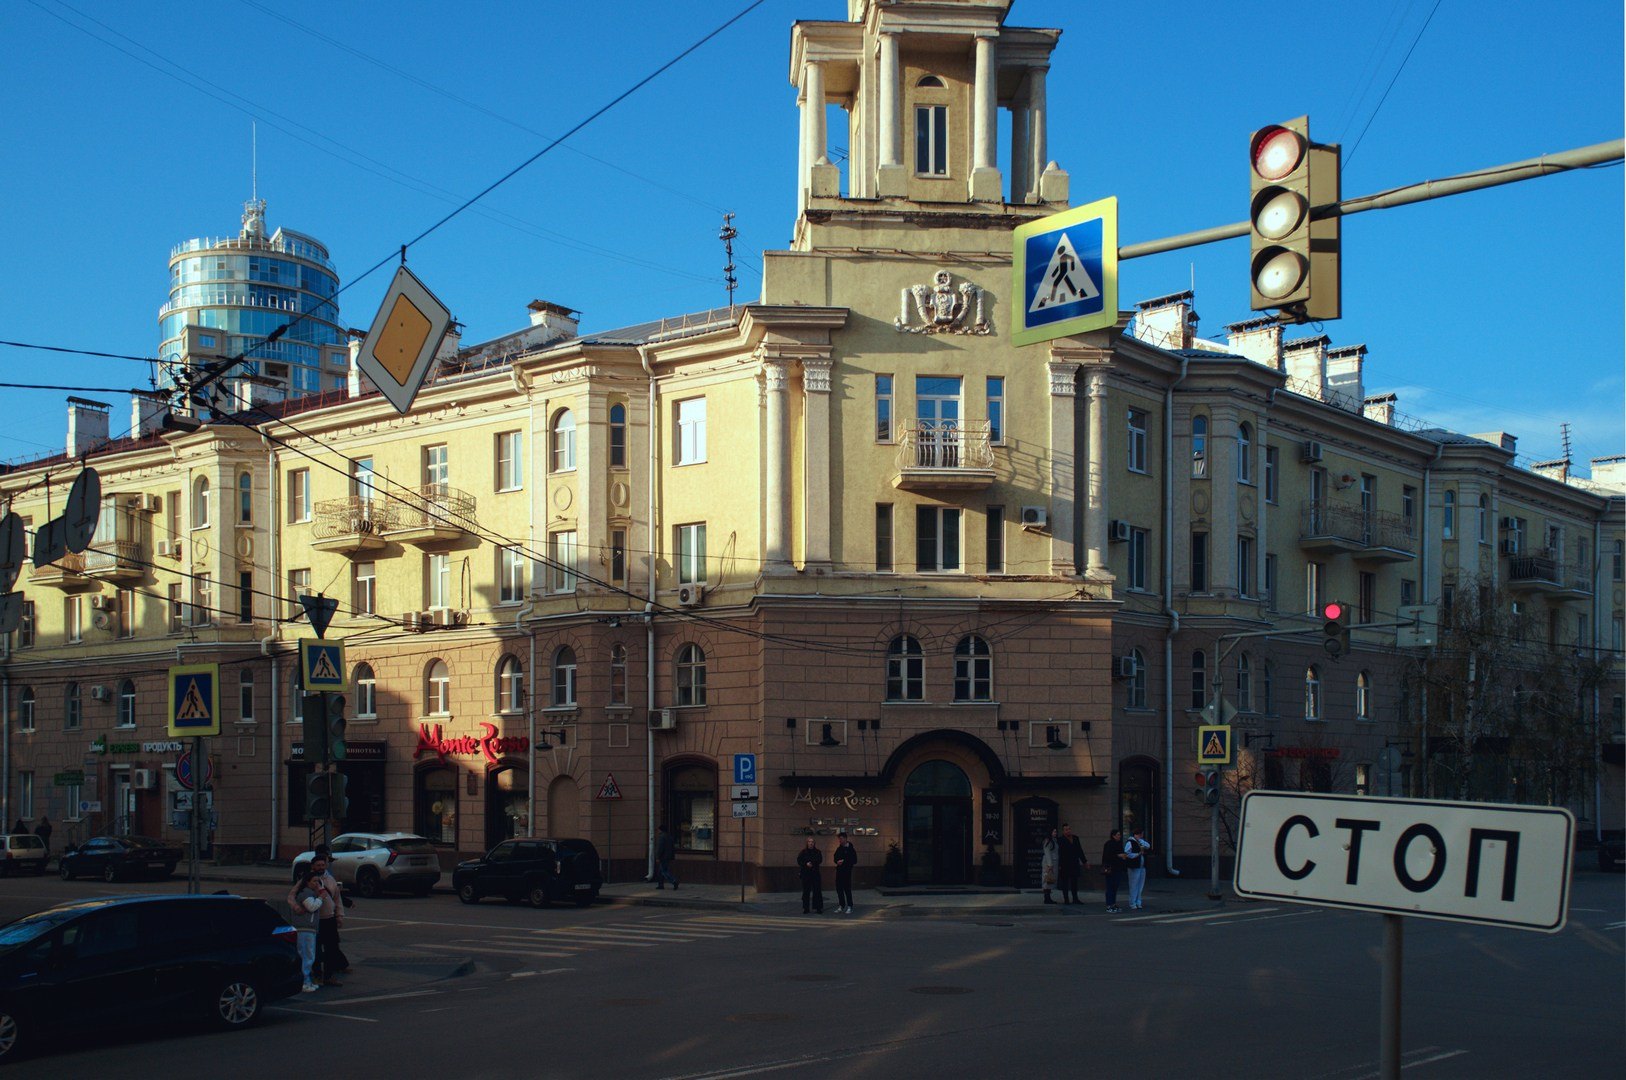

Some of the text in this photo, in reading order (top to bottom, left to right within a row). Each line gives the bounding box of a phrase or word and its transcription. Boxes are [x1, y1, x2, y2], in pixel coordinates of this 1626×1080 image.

[413, 722, 529, 766] Monte Rosso
[740, 757, 752, 780] P
[790, 786, 880, 811] Monte Rosso
[1274, 814, 1521, 902] СТОП
